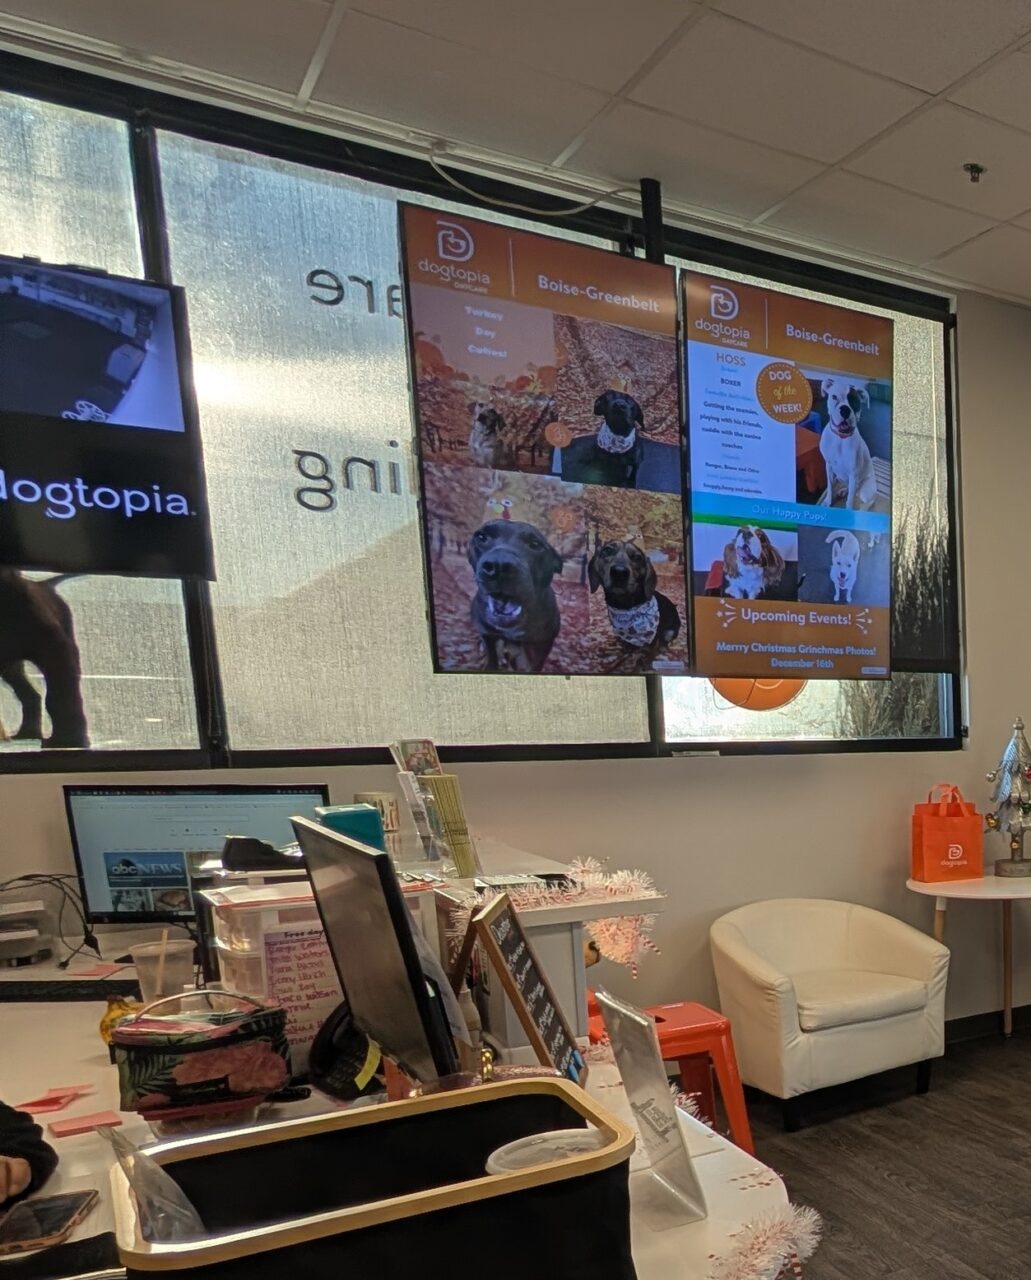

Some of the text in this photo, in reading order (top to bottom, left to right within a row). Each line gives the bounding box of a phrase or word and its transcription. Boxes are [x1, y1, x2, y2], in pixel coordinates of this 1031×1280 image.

[418, 258, 491, 285] dogtopia
[537, 274, 660, 313] Boise-Greenbelt
[695, 318, 750, 339] dogtopia
[786, 324, 880, 356] Boise-Greenbelt
[716, 352, 746, 367] HOSS
[720, 378, 741, 387] BOXER
[768, 371, 792, 380] DOG
[773, 384, 796, 400] of the
[772, 403, 802, 414] WEEK!
[772, 505, 802, 520] Happy
[740, 607, 852, 626] Upcoming Events!
[751, 642, 797, 654] Christmas
[799, 644, 844, 655] Grinchmas
[846, 646, 876, 656] Photos!
[771, 658, 814, 668] December
[111, 862, 183, 875] abc NEWS
[284, 930, 304, 939] Free
